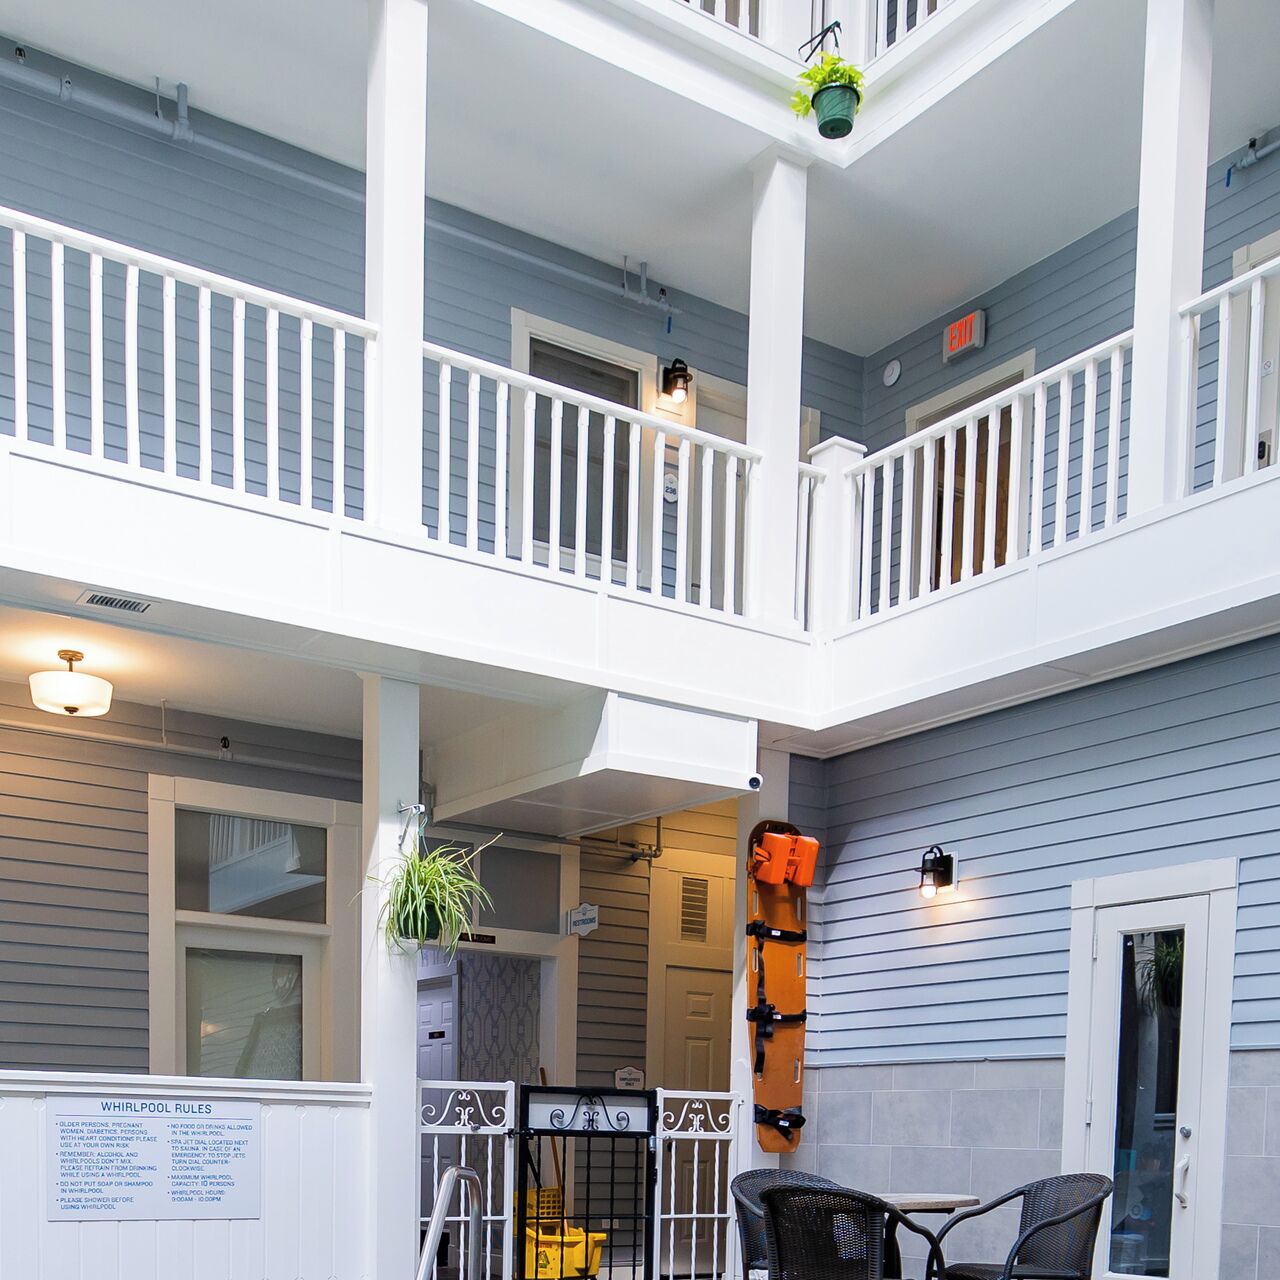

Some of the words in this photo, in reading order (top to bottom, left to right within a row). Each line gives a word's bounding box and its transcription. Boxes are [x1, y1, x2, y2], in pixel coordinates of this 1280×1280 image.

[949, 313, 976, 352] EXIT
[101, 1101, 171, 1113] WHIRLPOOL
[175, 1103, 212, 1114] RULES
